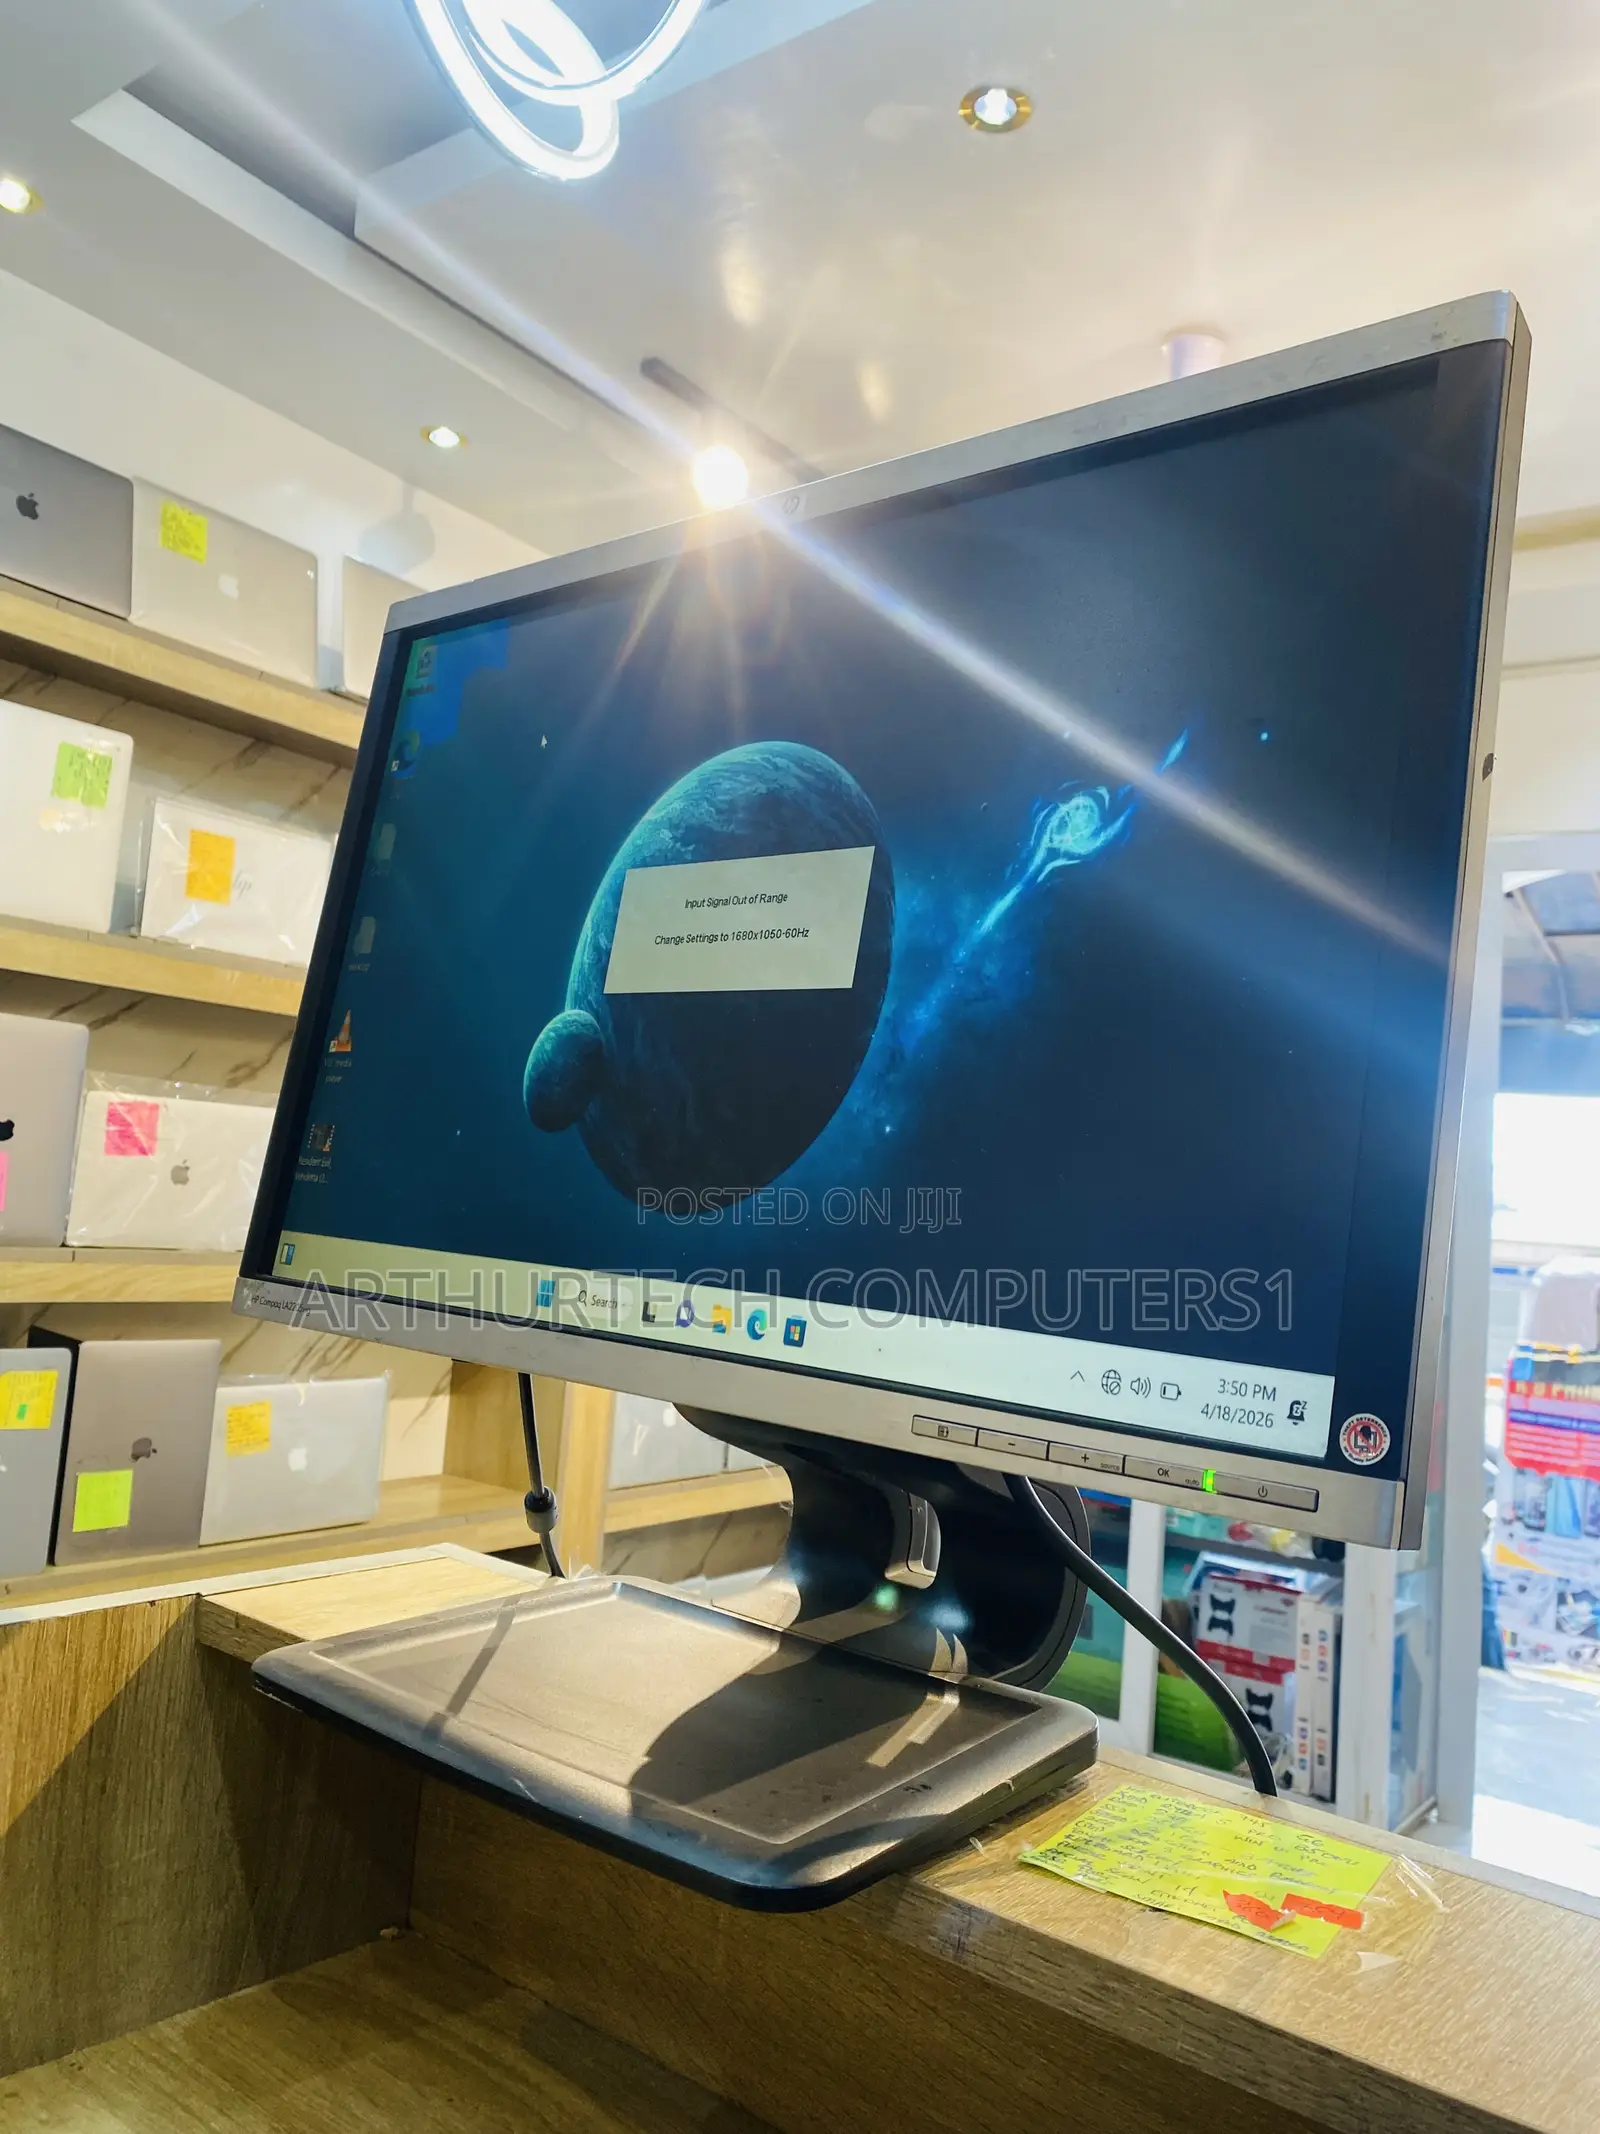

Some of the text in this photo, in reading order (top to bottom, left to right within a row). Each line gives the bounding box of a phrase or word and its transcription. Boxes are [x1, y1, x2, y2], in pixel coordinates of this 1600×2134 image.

[684, 893, 788, 909] Input Signal Out of Range
[654, 927, 810, 946] Change Settings to 1680x1050-60Hz
[260, 1296, 282, 1311] Compaq
[591, 1294, 619, 1310] Search
[1217, 1378, 1277, 1402] 3:50 PM
[1200, 1403, 1274, 1428] 4/18/2026
[1100, 1462, 1121, 1472] source
[1157, 1467, 1170, 1478] OK
[1185, 1477, 1200, 1486] auto
